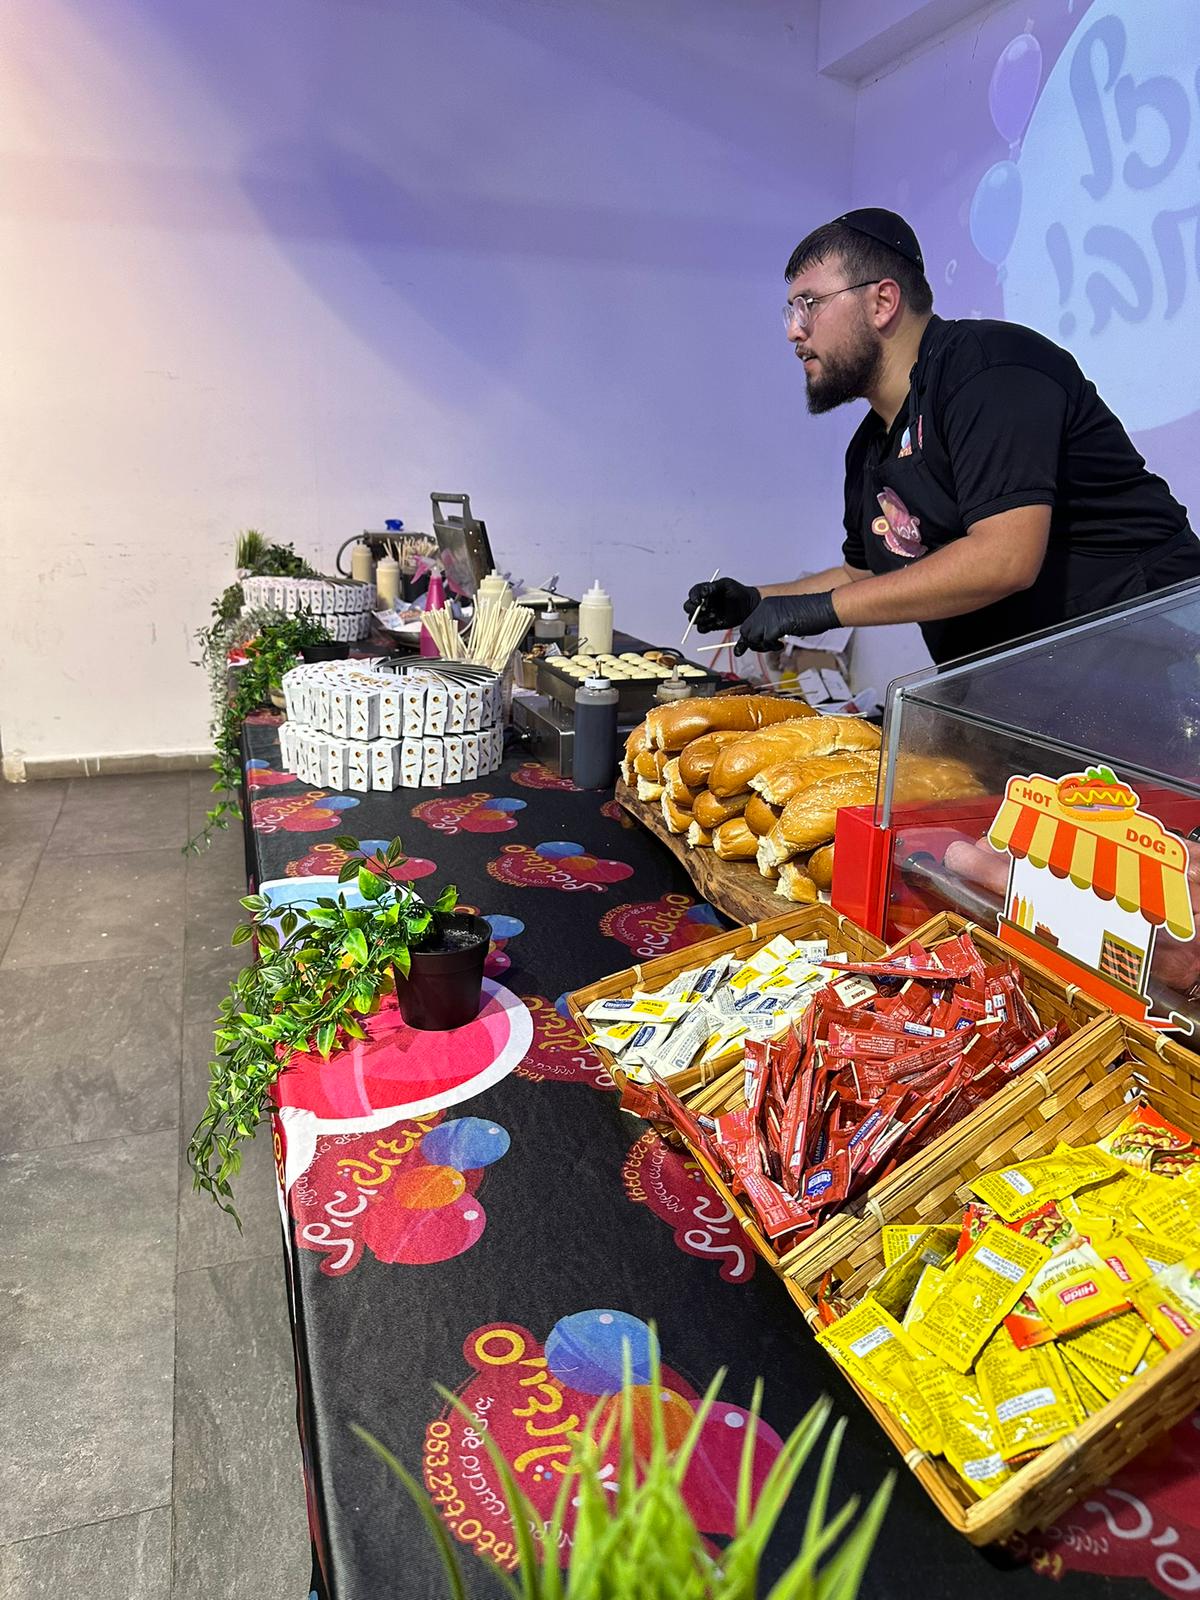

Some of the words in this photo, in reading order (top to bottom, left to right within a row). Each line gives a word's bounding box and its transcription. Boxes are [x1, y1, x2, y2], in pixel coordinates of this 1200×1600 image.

[1023, 787, 1053, 807] HOT
[1126, 828, 1166, 855] DOG
[1063, 1284, 1094, 1303] Hilda
